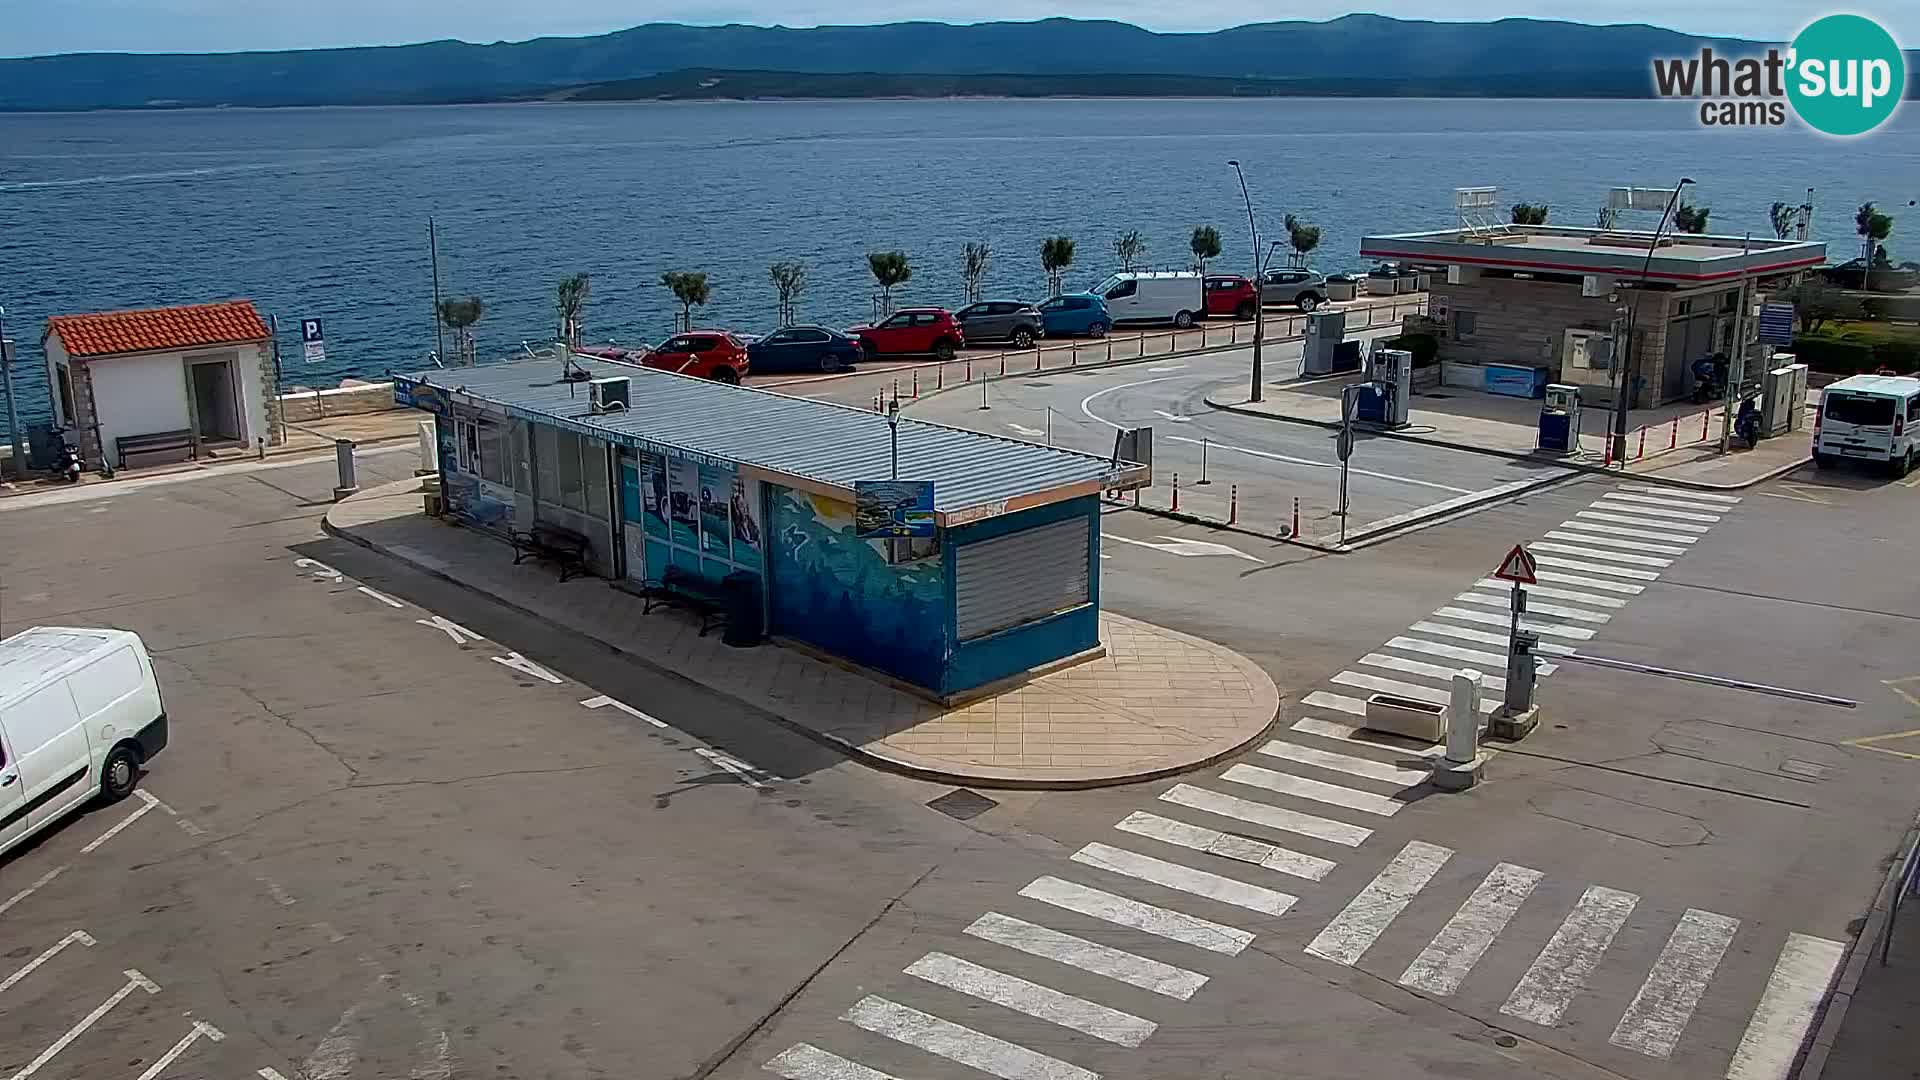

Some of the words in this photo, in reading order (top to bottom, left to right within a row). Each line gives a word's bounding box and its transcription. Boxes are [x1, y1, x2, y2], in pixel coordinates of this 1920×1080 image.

[305, 321, 318, 339] P
[649, 443, 680, 458] STATION
[683, 450, 707, 465] TICKET
[708, 456, 735, 471] OFFICE
